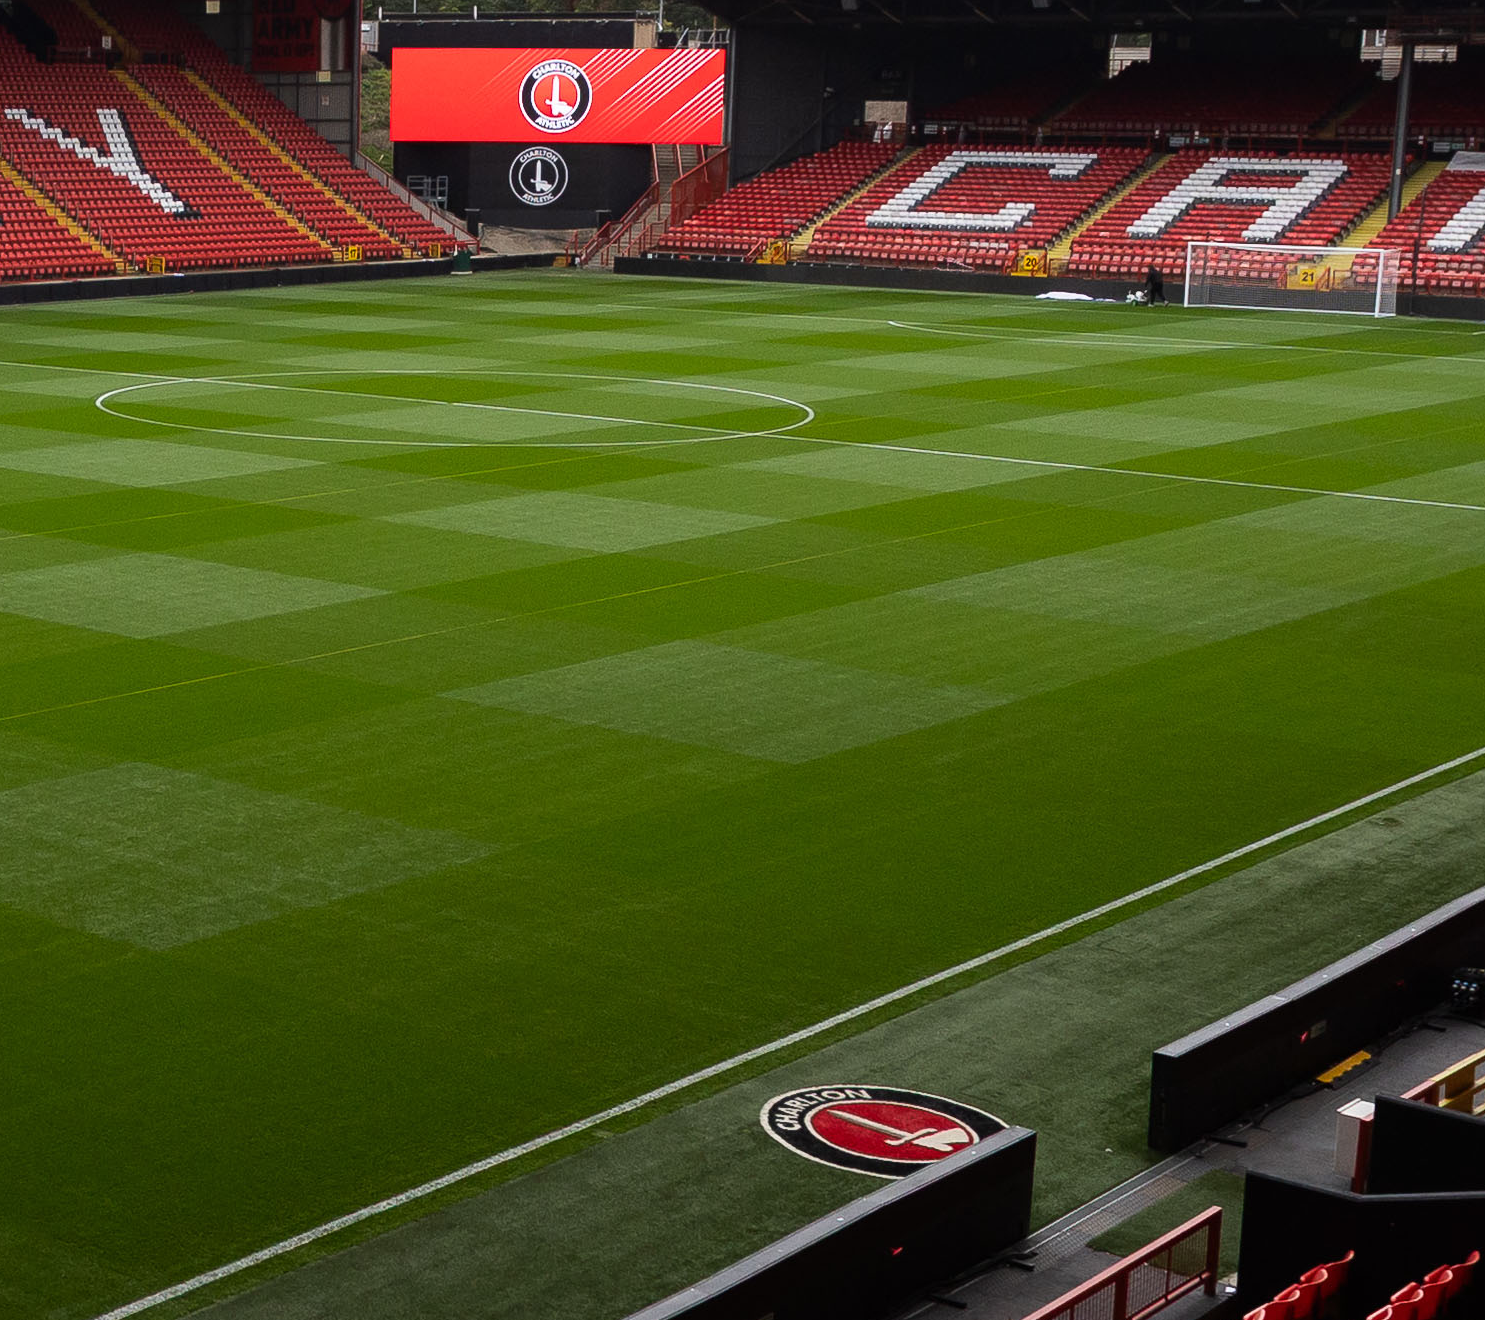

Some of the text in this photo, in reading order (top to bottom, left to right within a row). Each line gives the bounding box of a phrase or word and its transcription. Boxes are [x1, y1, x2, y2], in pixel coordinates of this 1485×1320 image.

[532, 62, 580, 80] CHARLTON
[535, 115, 575, 129] ATHLETIC
[519, 149, 558, 163] CHARLTON
[522, 192, 554, 204] ATHLETIC
[1026, 257, 1037, 268] 20
[1302, 271, 1314, 282] 21
[775, 1089, 872, 1131] CHARLTON
